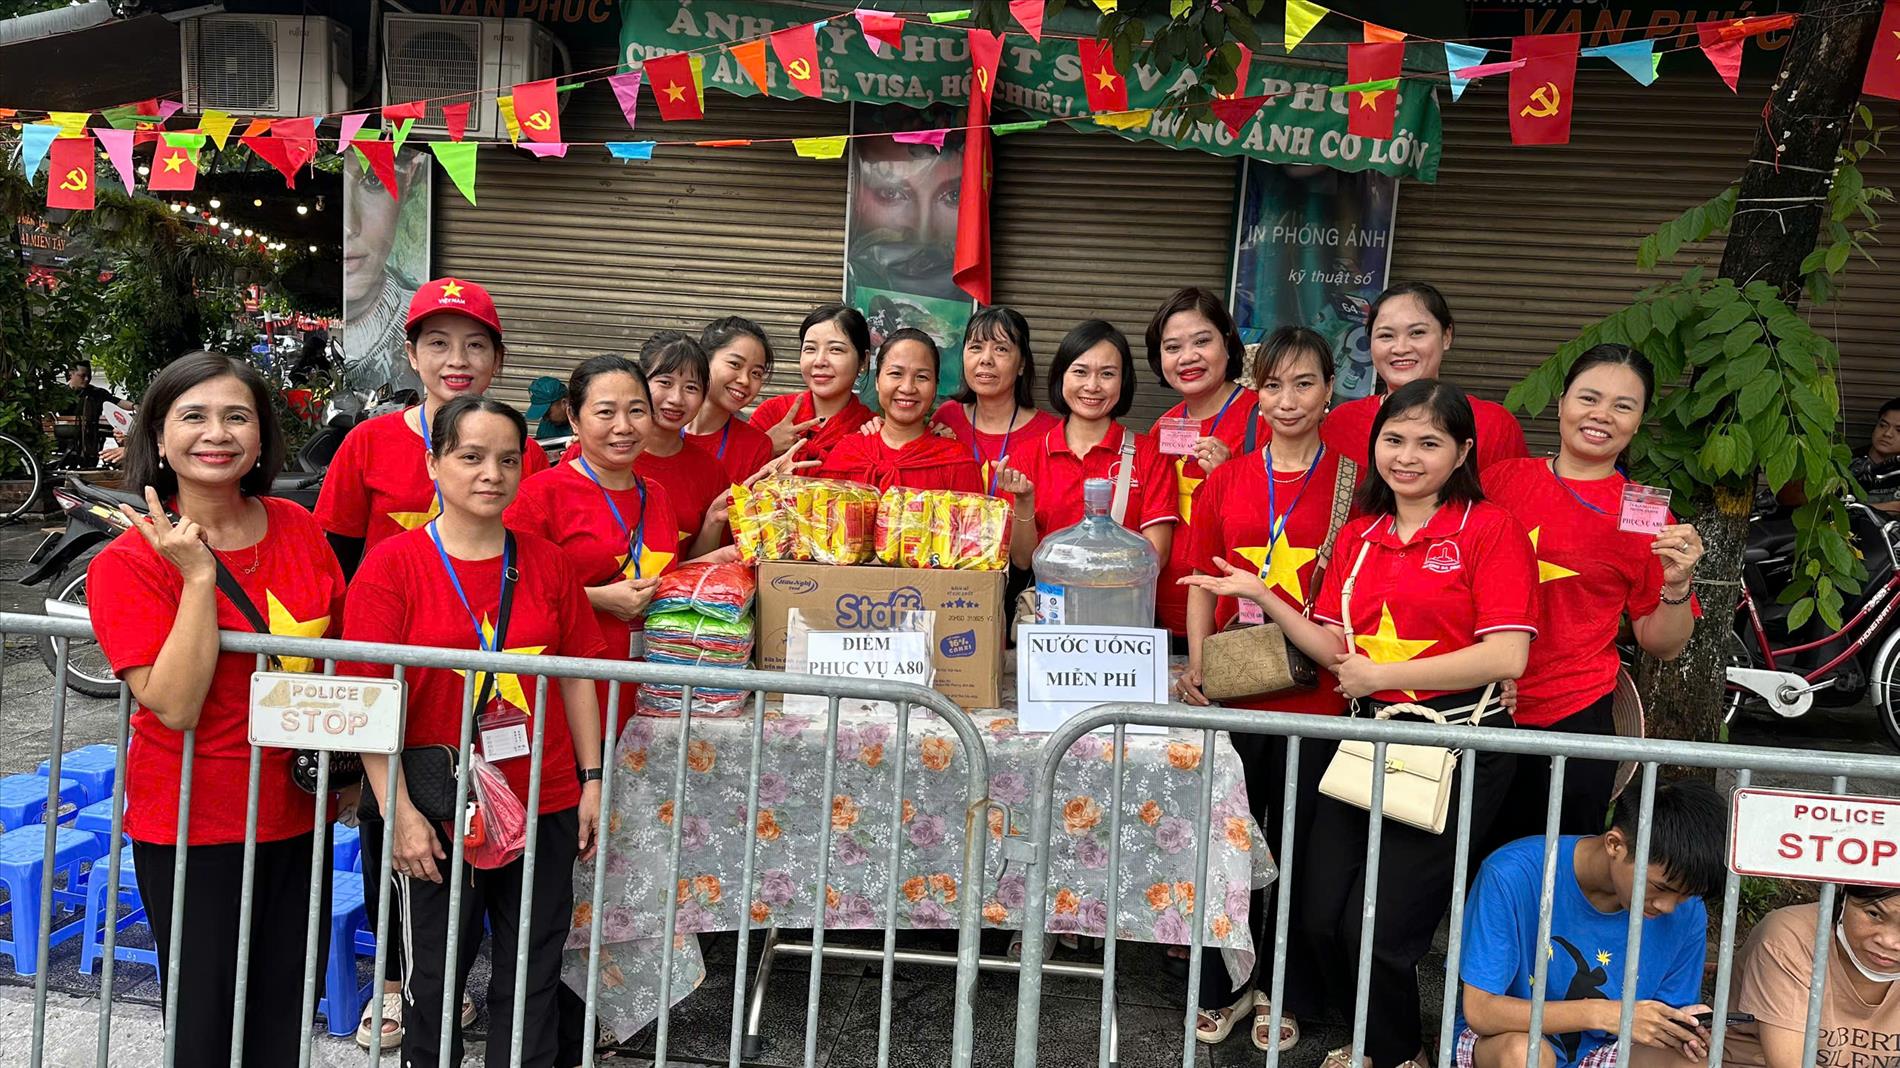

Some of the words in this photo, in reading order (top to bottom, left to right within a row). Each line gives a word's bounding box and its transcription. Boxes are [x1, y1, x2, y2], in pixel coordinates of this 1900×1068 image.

[854, 72, 934, 101] VISA,
[1241, 108, 1314, 156] ẢNH
[1272, 223, 1340, 246] PHÓNG
[1344, 223, 1386, 248] ẢNH
[1288, 269, 1306, 285] kỹ
[1311, 269, 1350, 286] thuật
[1353, 269, 1375, 285] số
[1031, 634, 1089, 653] NƯỚC
[1095, 636, 1152, 656] UỐNG
[864, 661, 889, 678] VỤ
[894, 661, 924, 675] A80
[1103, 668, 1137, 687] PHÍ
[292, 684, 359, 701] POLICE
[281, 708, 369, 736] STOP
[1793, 804, 1886, 826] POLICE
[1777, 832, 1898, 867] STOP
